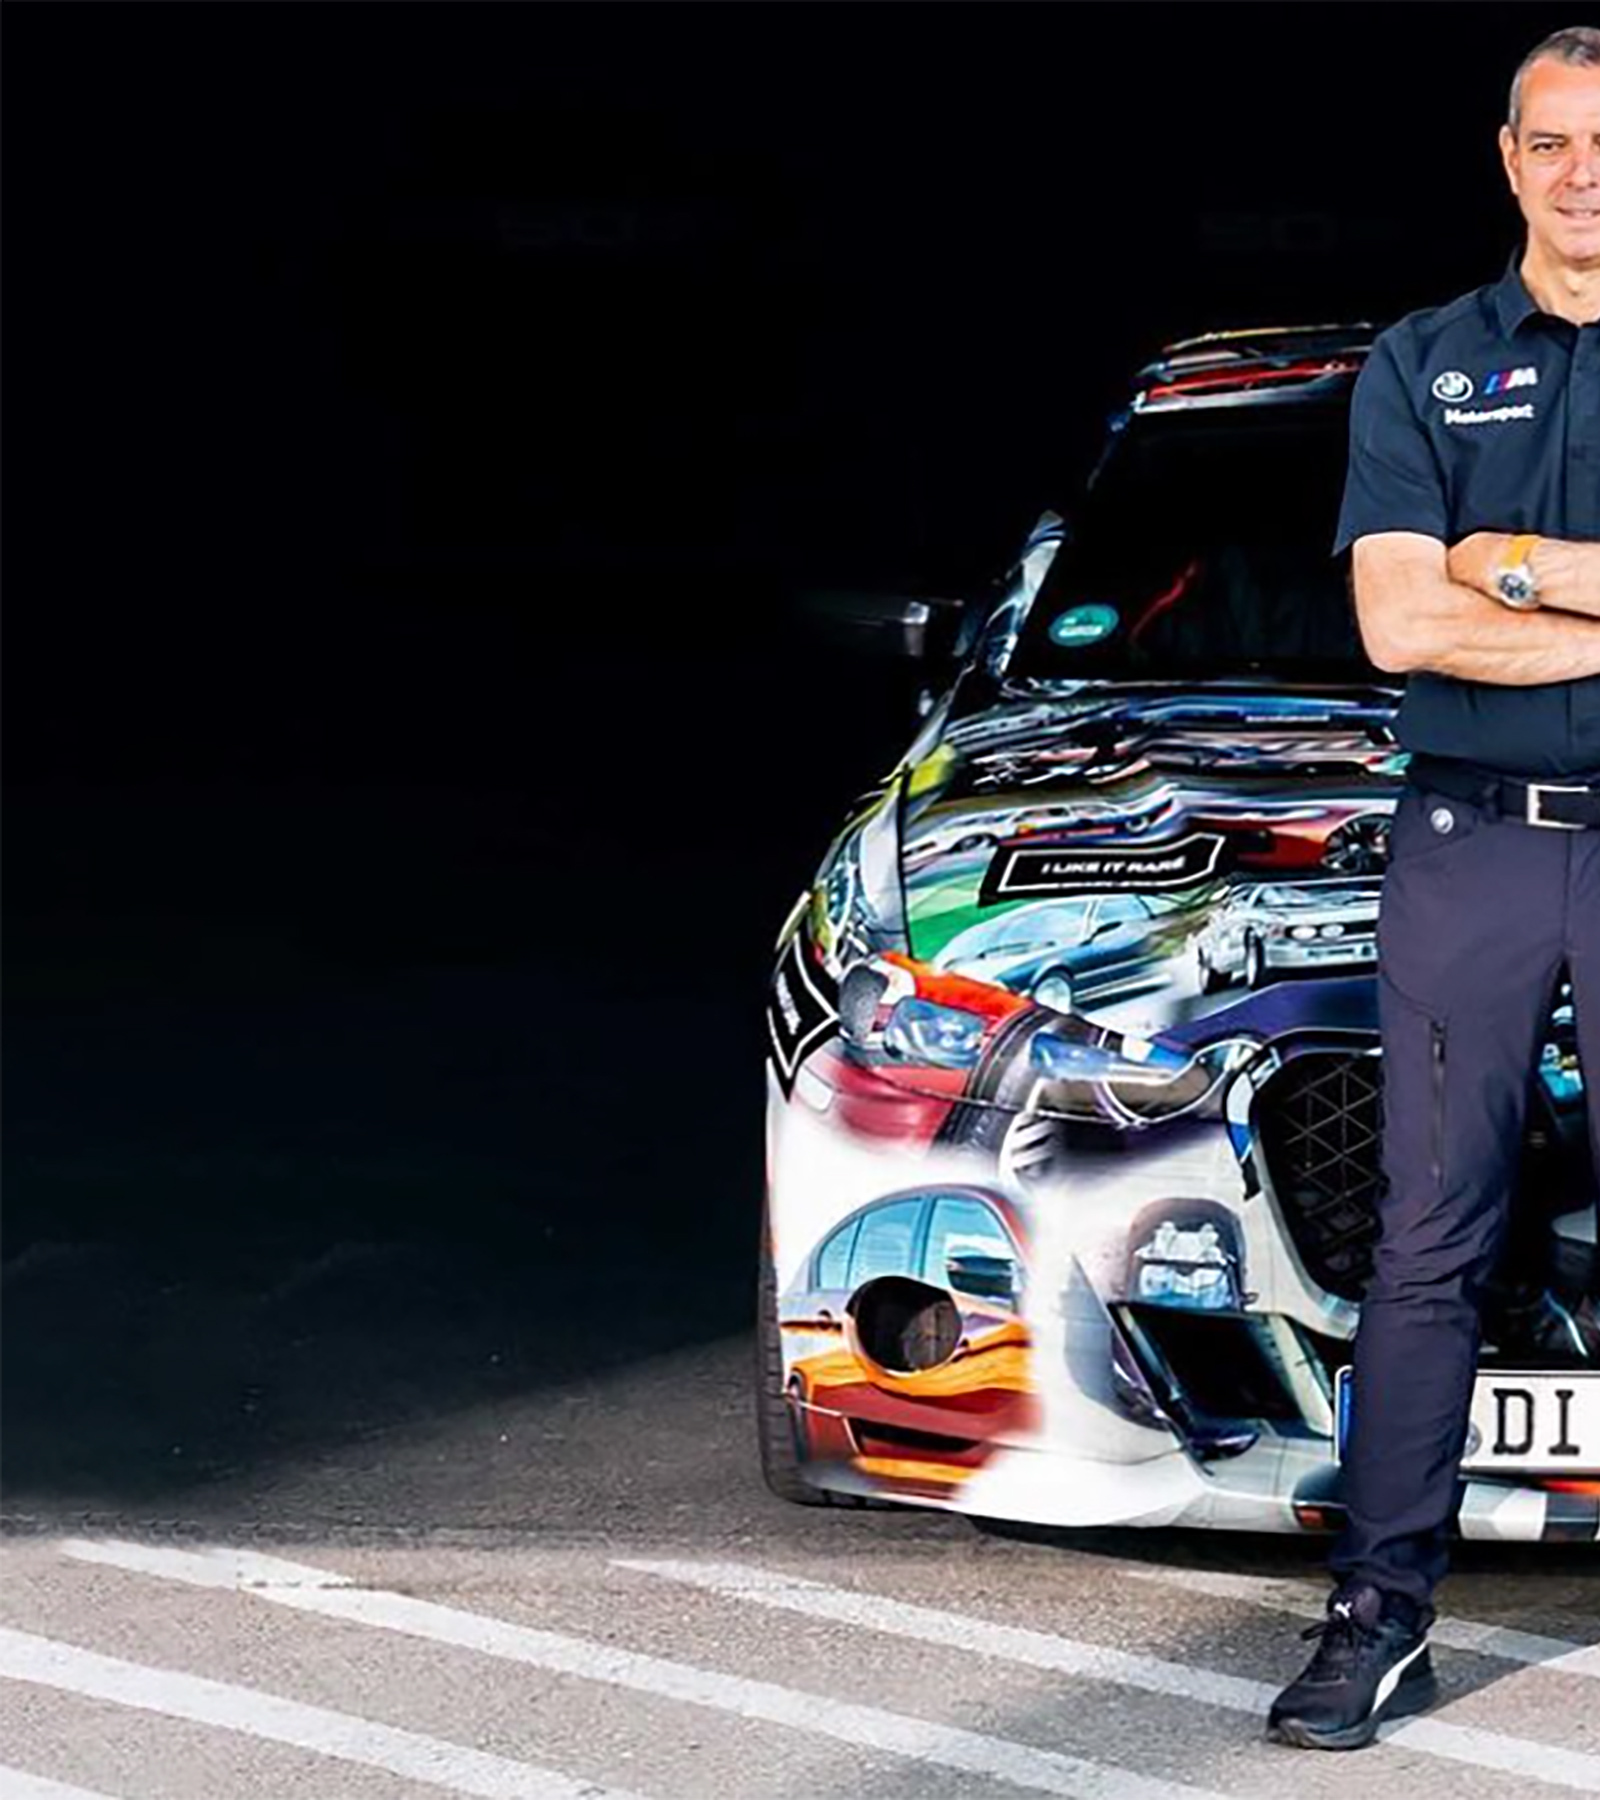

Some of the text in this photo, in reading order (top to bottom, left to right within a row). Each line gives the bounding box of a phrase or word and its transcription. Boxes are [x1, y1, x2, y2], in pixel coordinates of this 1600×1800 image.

[1444, 403, 1534, 425] Motorsport
[1040, 862, 1050, 875] I
[1052, 862, 1100, 874] LIKE
[1102, 861, 1126, 874] IT
[1492, 1388, 1581, 1457] DI
